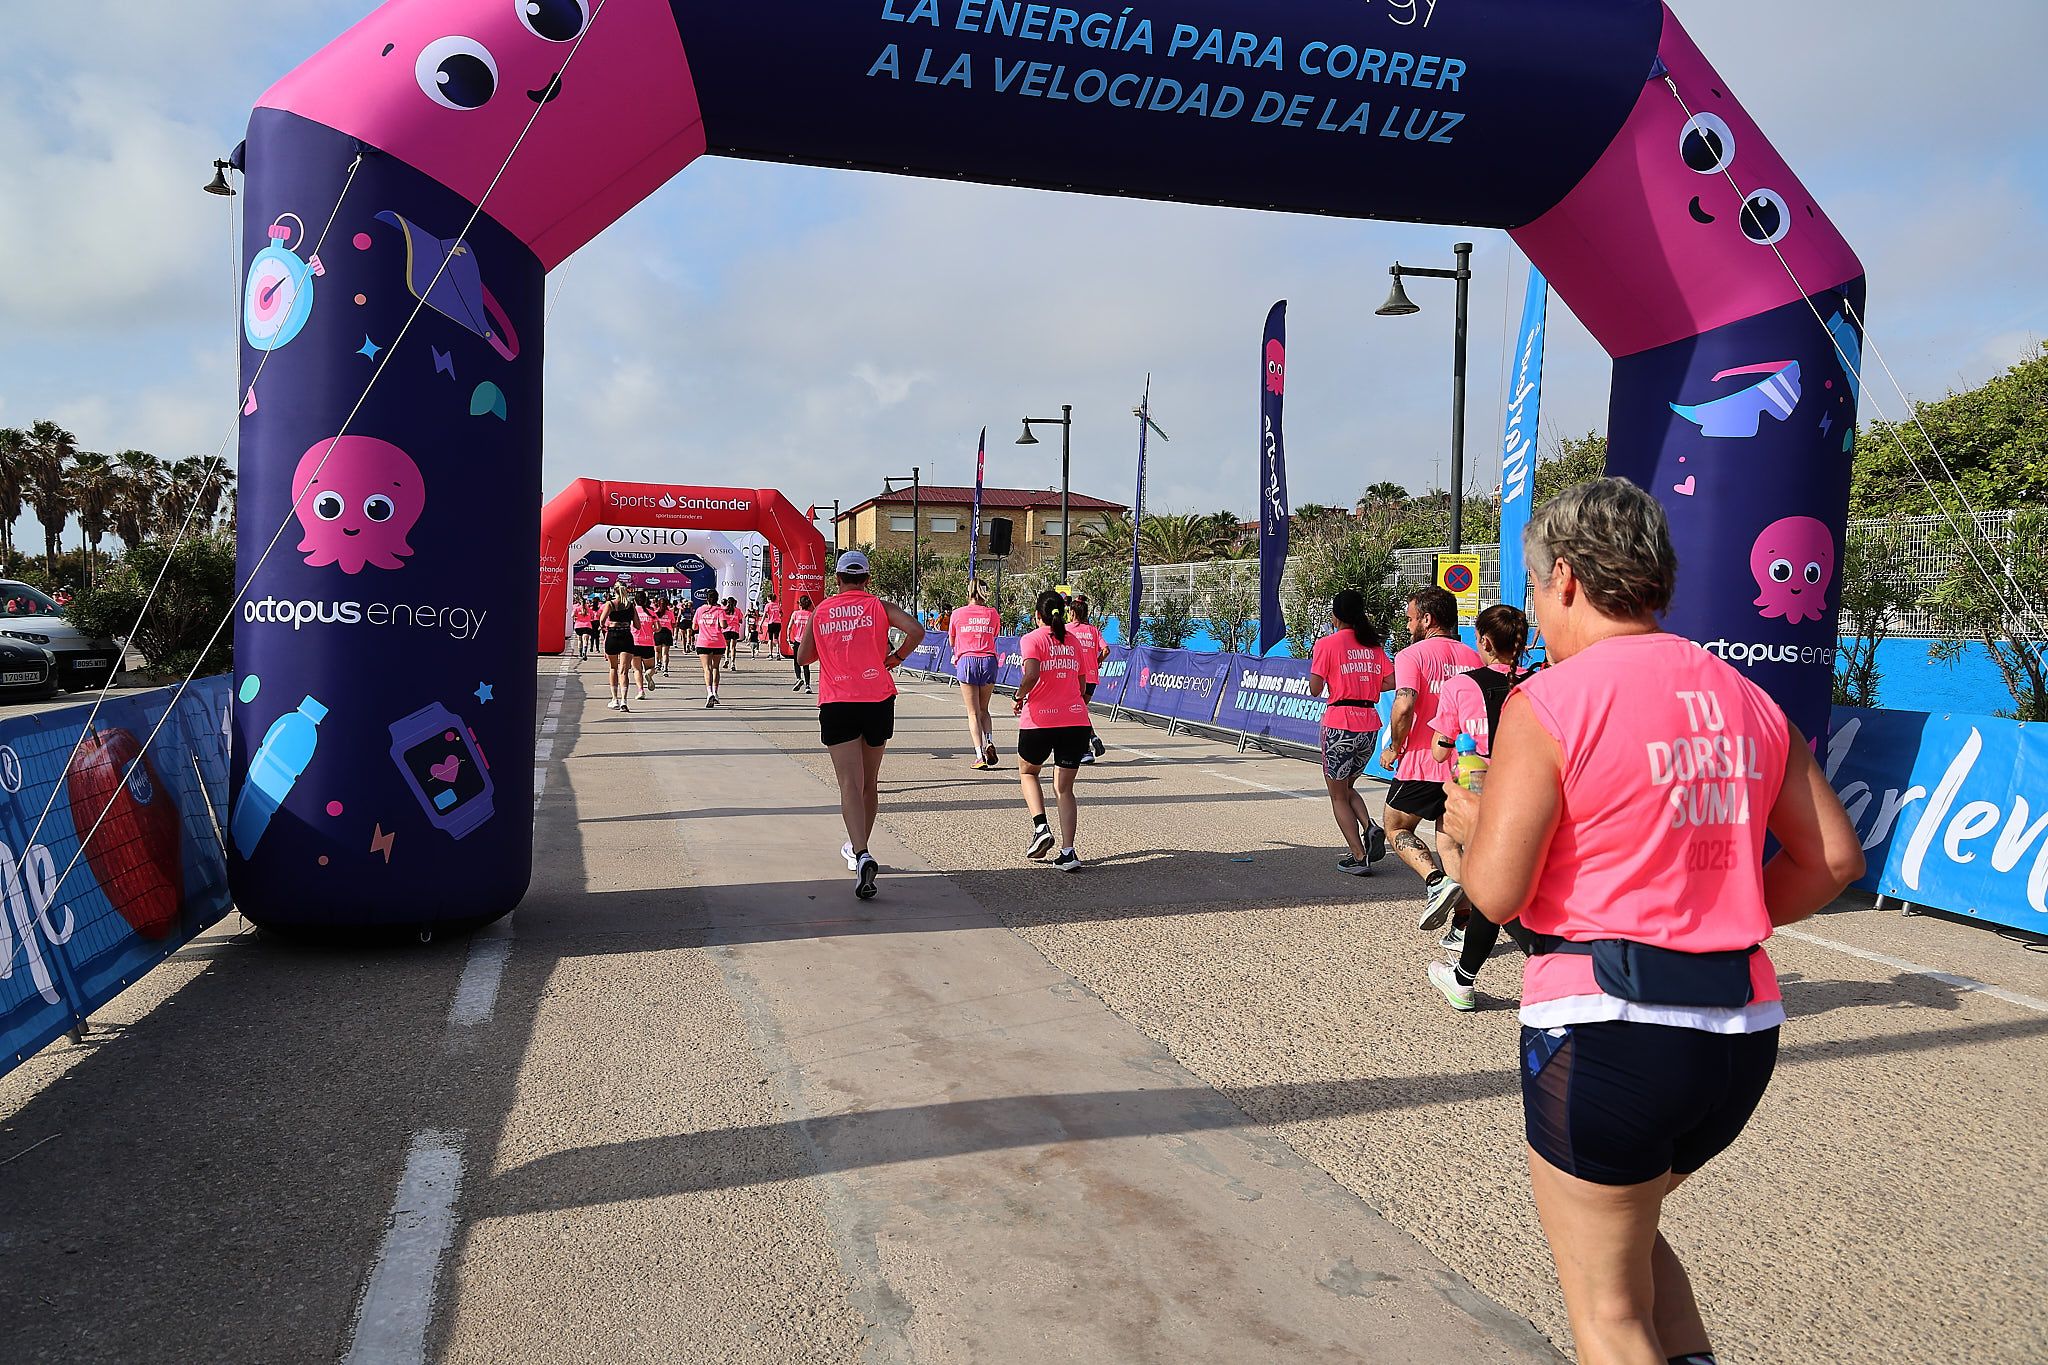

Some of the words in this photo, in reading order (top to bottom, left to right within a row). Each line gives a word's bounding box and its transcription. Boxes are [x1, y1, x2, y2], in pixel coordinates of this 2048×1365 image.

[881, 0, 940, 27] LA
[955, 0, 1153, 54] ENERGÍA
[1167, 22, 1283, 71] PARA
[1299, 41, 1467, 92] CORRER
[866, 43, 900, 80] A
[915, 48, 972, 89] LA
[994, 57, 1245, 120] VELOCIDAD
[1251, 90, 1314, 127] DE
[1317, 98, 1371, 135] LA
[1379, 105, 1466, 144] LUZ
[610, 492, 655, 509] Sports
[679, 496, 751, 511] Santander
[606, 528, 688, 546] OYSHO
[748, 544, 762, 602] OYSHO
[244, 596, 362, 630] octopus
[367, 603, 487, 639] energy
[829, 605, 864, 619] SOMOS
[1049, 644, 1075, 656] SOMOS
[1347, 648, 1375, 660] SOMOS
[4, 673, 24, 682] 1709
[24, 671, 39, 681] HZX
[1149, 670, 1184, 692] octopus
[1183, 675, 1216, 698] energy
[1240, 669, 1259, 688] Solo
[1258, 674, 1283, 691] unos
[1234, 690, 1248, 710] YA
[1245, 692, 1259, 711] LO
[1257, 692, 1278, 714] HAS
[1675, 690, 1725, 733] TU
[1646, 735, 1763, 786] DORSAL
[1686, 839, 1738, 873] 2025
